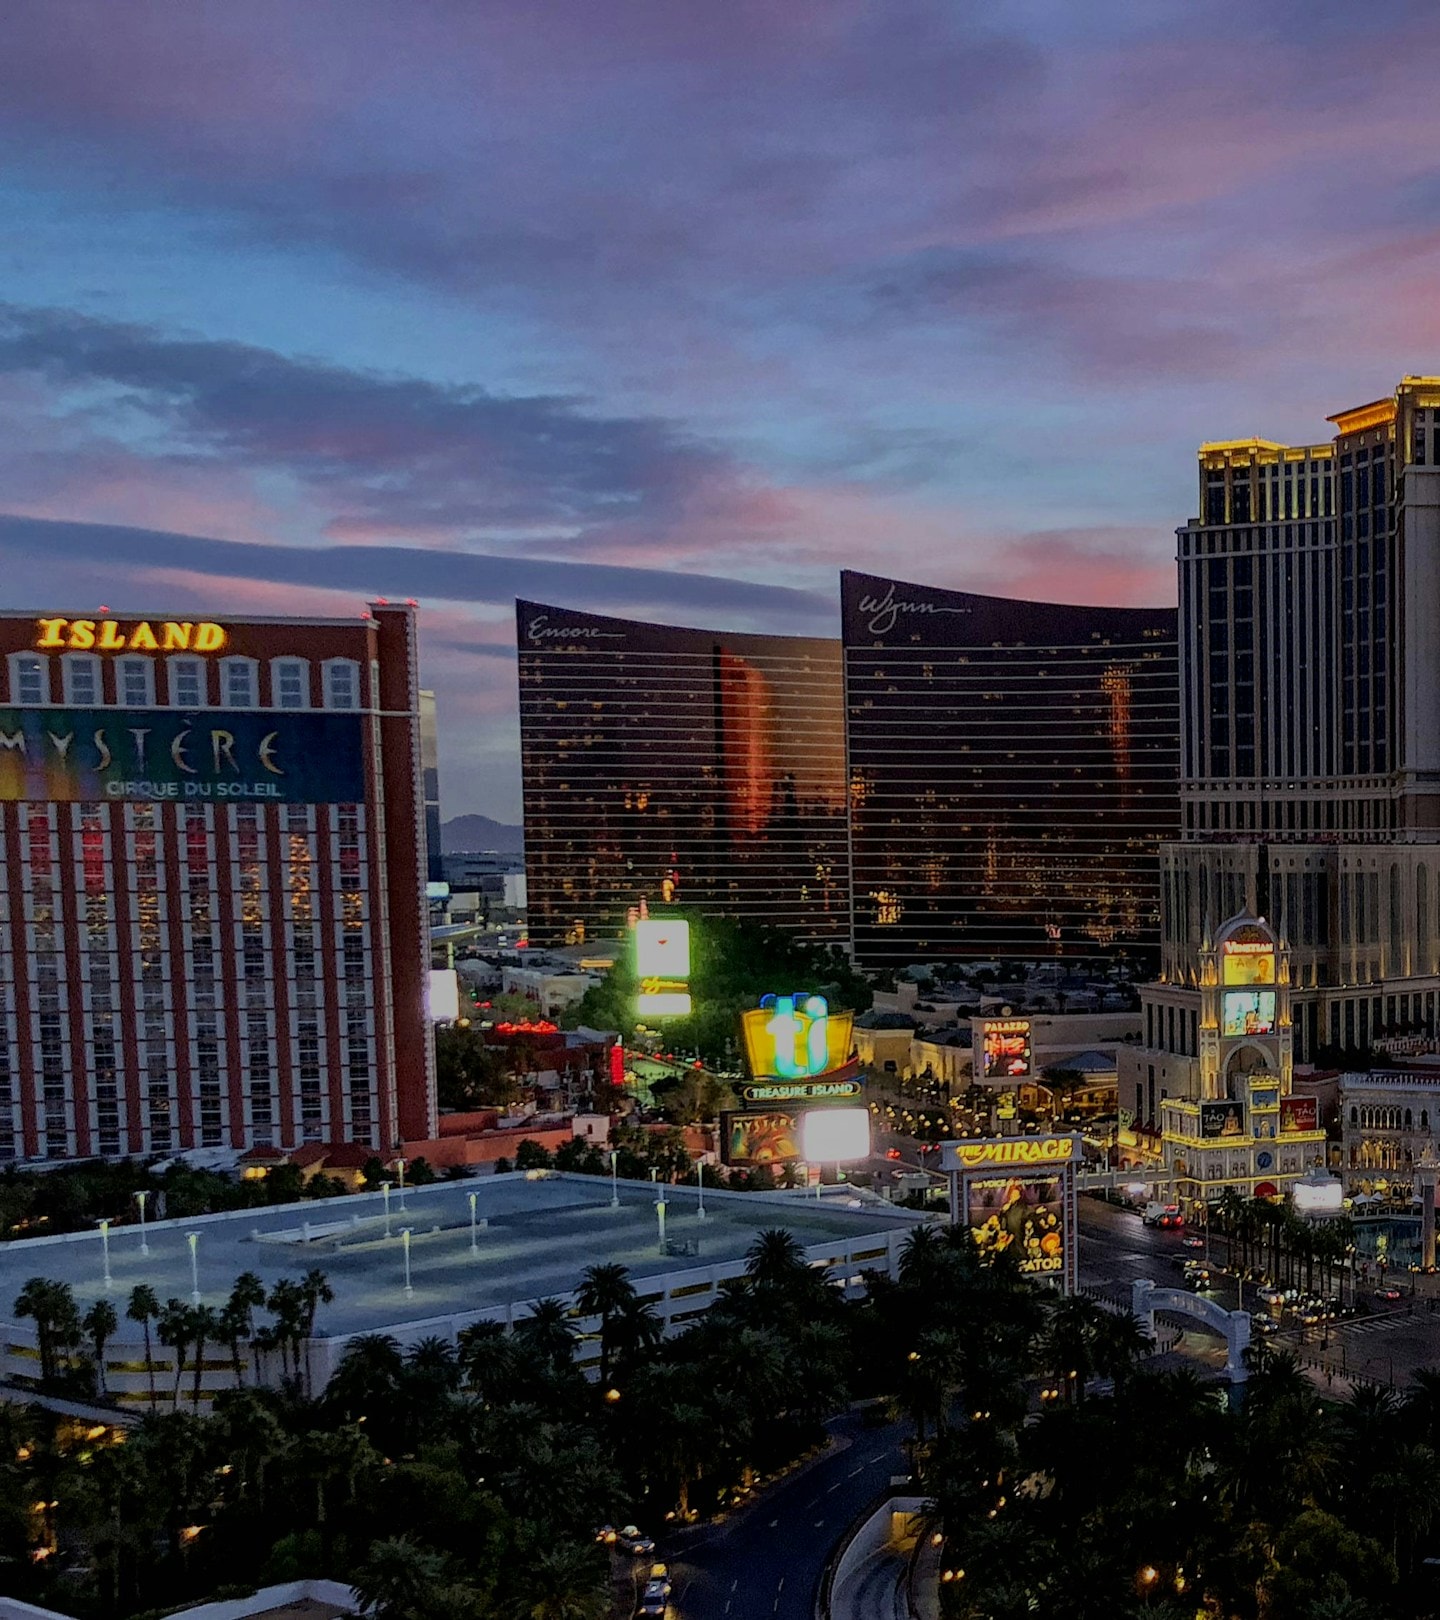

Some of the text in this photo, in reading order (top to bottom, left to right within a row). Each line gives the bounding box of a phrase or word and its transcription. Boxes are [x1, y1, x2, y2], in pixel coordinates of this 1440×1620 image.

[37, 618, 226, 650] ISLAND
[528, 615, 626, 640] Encore
[106, 780, 283, 799] CIRQUE DU SOLEIL
[984, 1021, 1030, 1032] PALAZZO
[752, 1083, 854, 1098] TREASURE ISLAND
[1203, 1113, 1225, 1122] TAO
[1296, 1107, 1317, 1116] TAO
[956, 1138, 1074, 1166] THE MIRAGE
